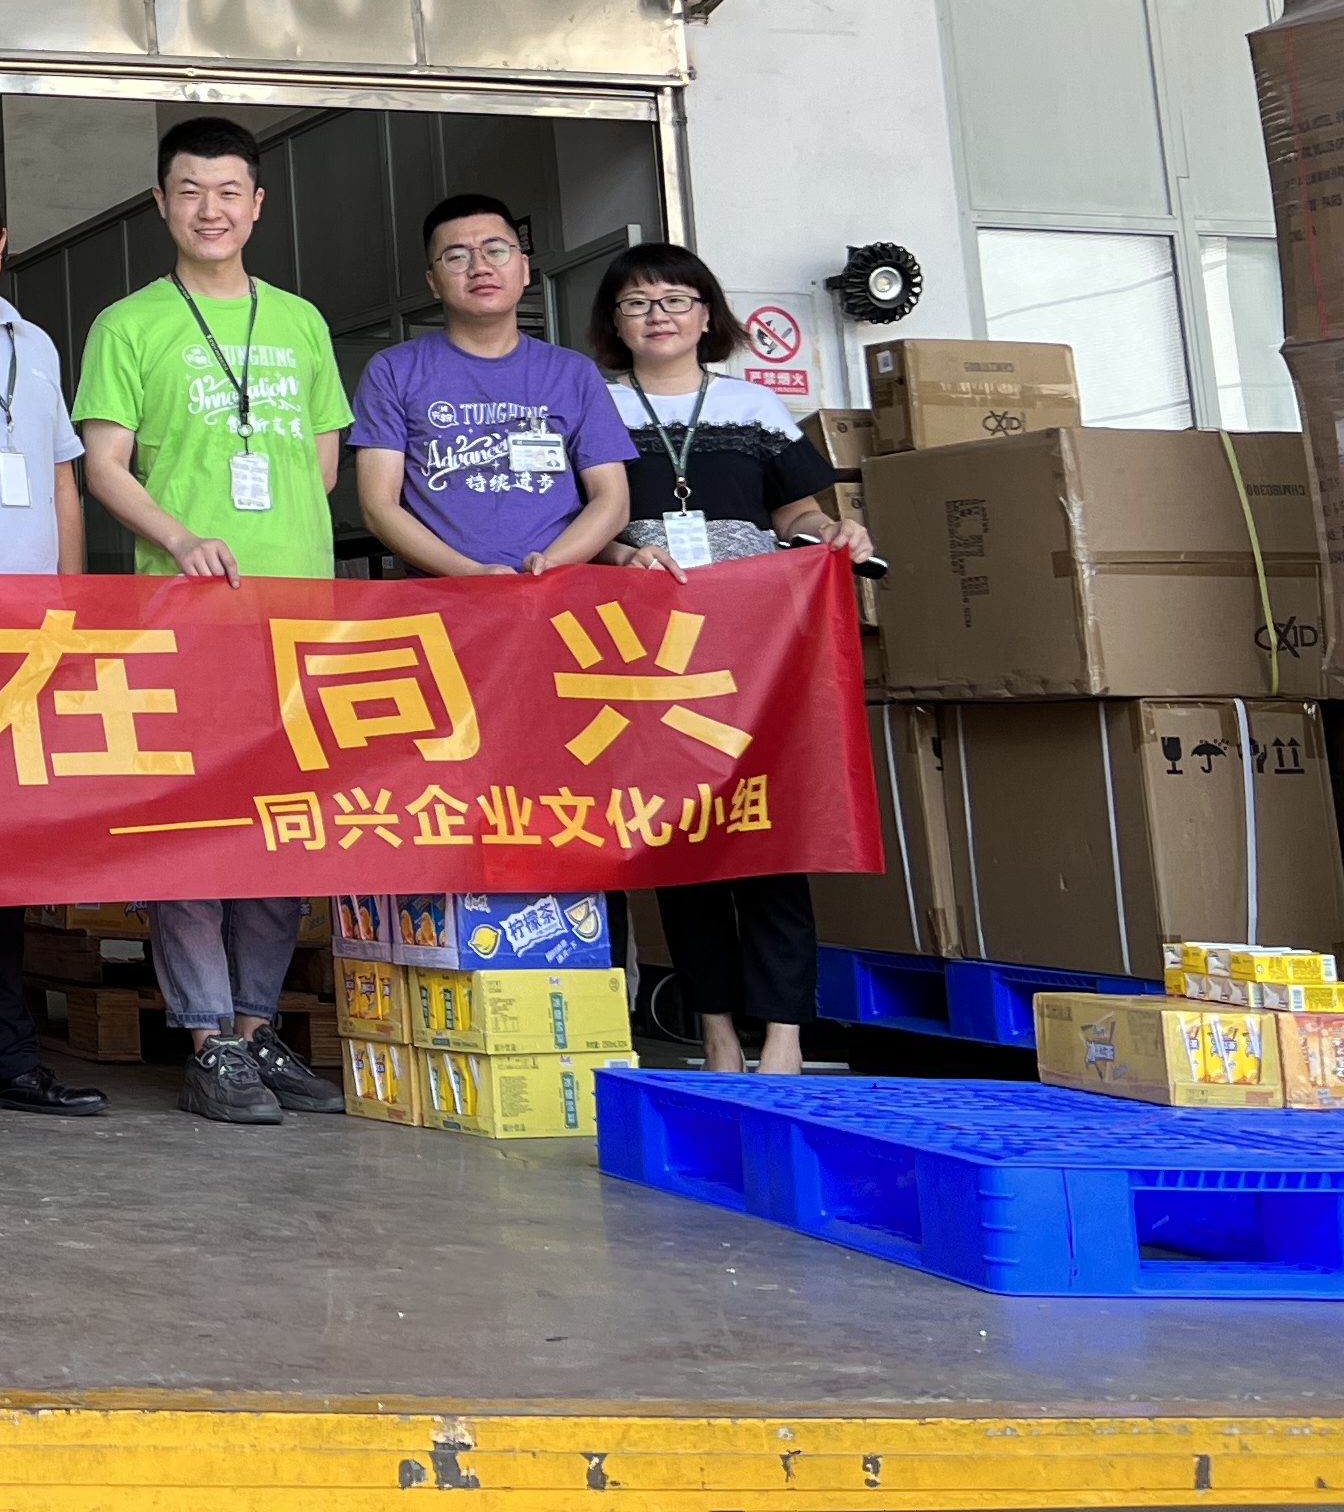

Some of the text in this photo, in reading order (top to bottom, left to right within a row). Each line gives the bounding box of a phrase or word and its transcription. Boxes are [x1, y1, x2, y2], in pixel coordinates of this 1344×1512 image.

[188, 375, 300, 414] Innoation
[460, 402, 550, 425] TUNGHING
[465, 471, 555, 494] 持续进步
[508, 902, 557, 942] 柠檬茶
